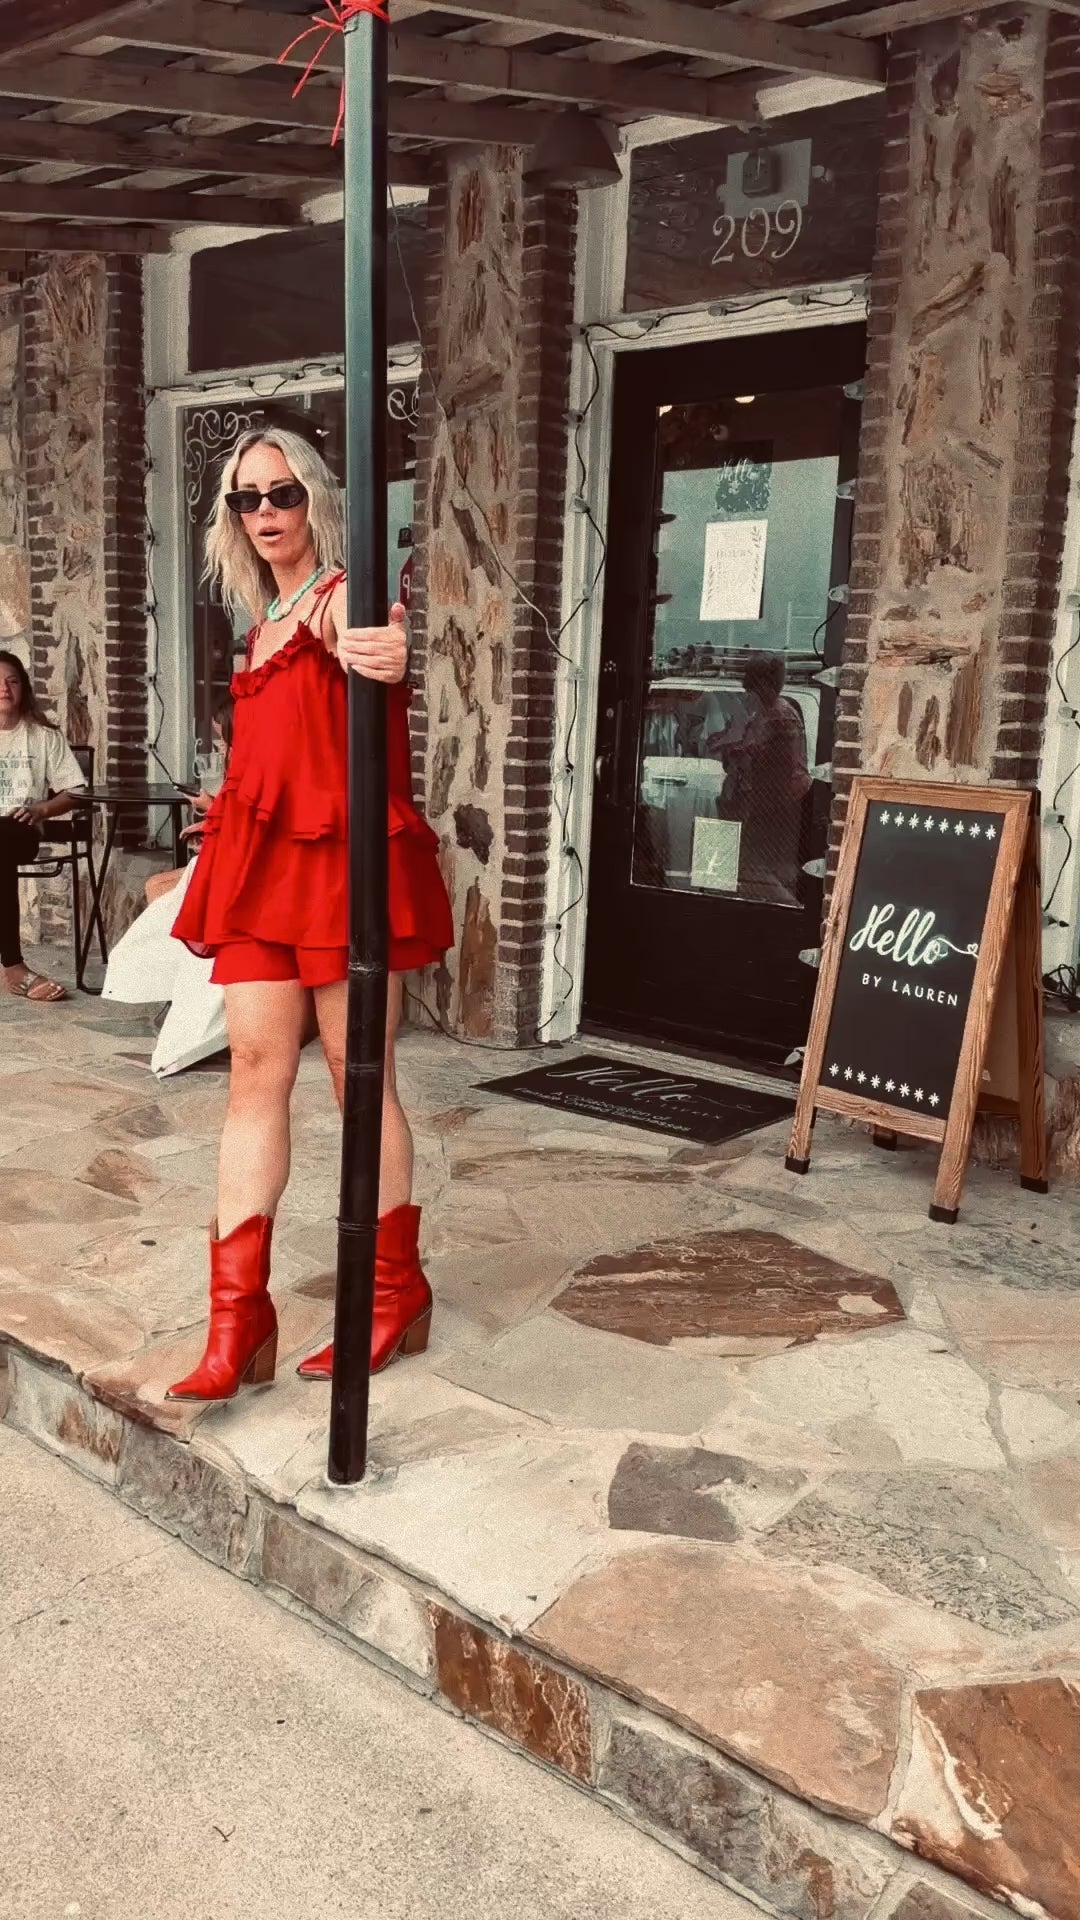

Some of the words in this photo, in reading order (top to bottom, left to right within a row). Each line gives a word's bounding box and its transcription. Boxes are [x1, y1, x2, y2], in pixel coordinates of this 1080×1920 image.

[711, 199, 802, 265] 209
[849, 903, 950, 967] Hello
[862, 973, 882, 988] BY
[892, 980, 958, 1006] LAUREN
[546, 1066, 698, 1102] Hello
